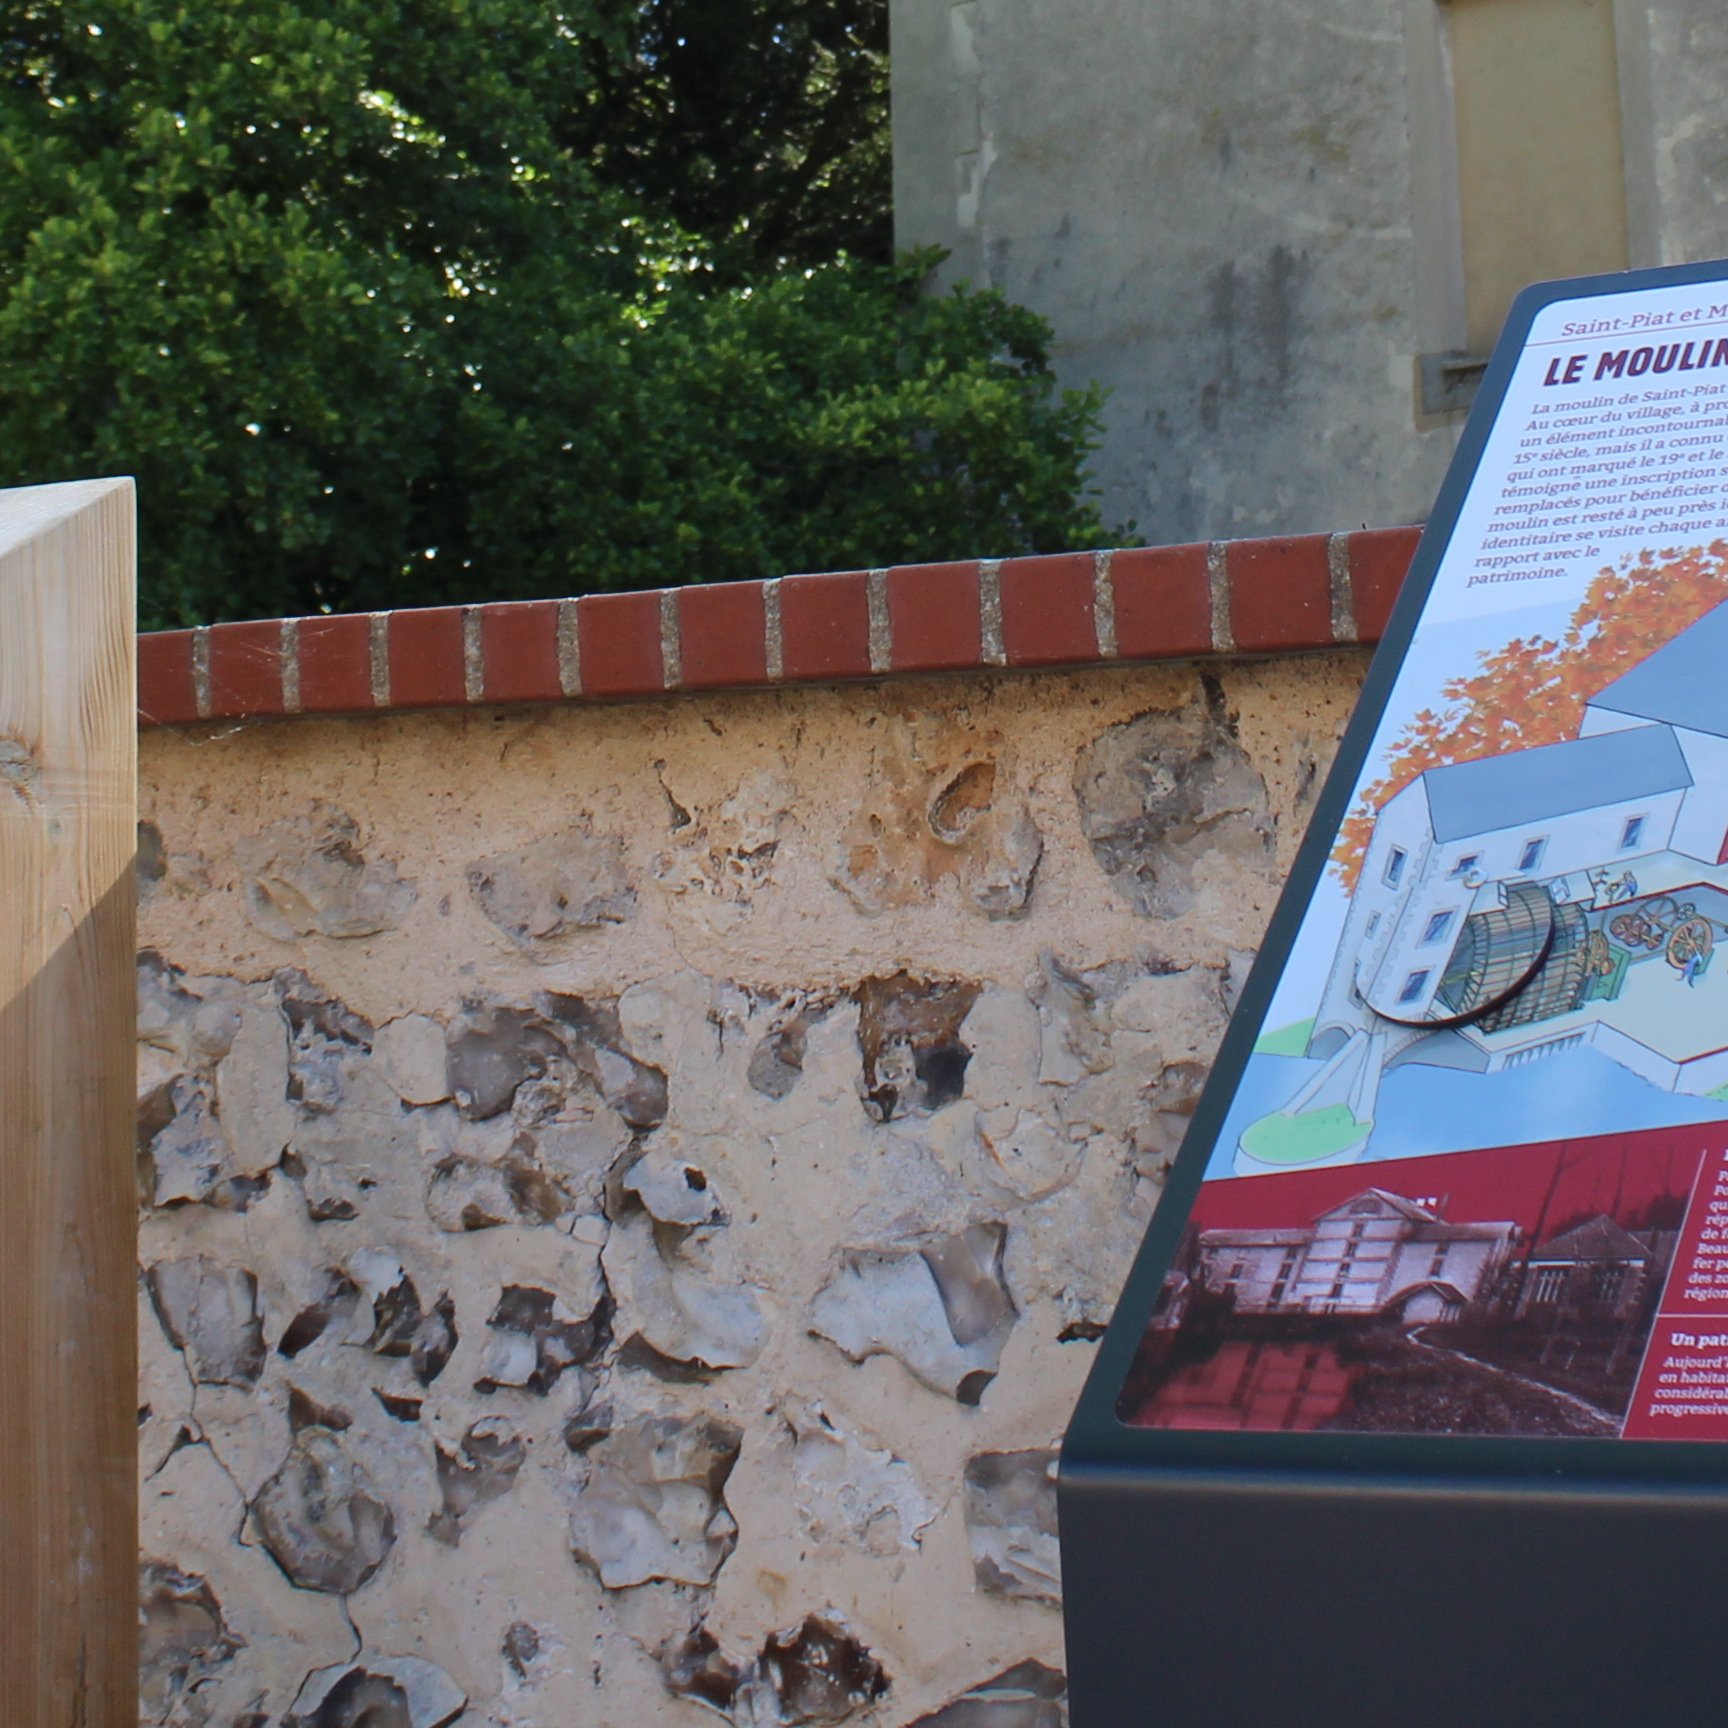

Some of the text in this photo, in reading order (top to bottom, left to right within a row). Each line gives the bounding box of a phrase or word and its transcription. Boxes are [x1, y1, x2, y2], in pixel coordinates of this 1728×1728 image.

[1562, 309, 1675, 336] Saint-Piat
[1679, 306, 1703, 322] et
[1543, 353, 1588, 386] LE
[1533, 402, 1549, 414] La
[1554, 395, 1614, 412] moulin
[1618, 393, 1638, 404] de
[1642, 382, 1726, 402] Saint-Piat
[1525, 418, 1549, 430] Au
[1553, 414, 1598, 427] cœur
[1600, 410, 1622, 422] du
[1627, 405, 1685, 419] village,
[1690, 401, 1700, 412] à
[1683, 1288, 1728, 1301] région
[1671, 1333, 1694, 1345] Un
